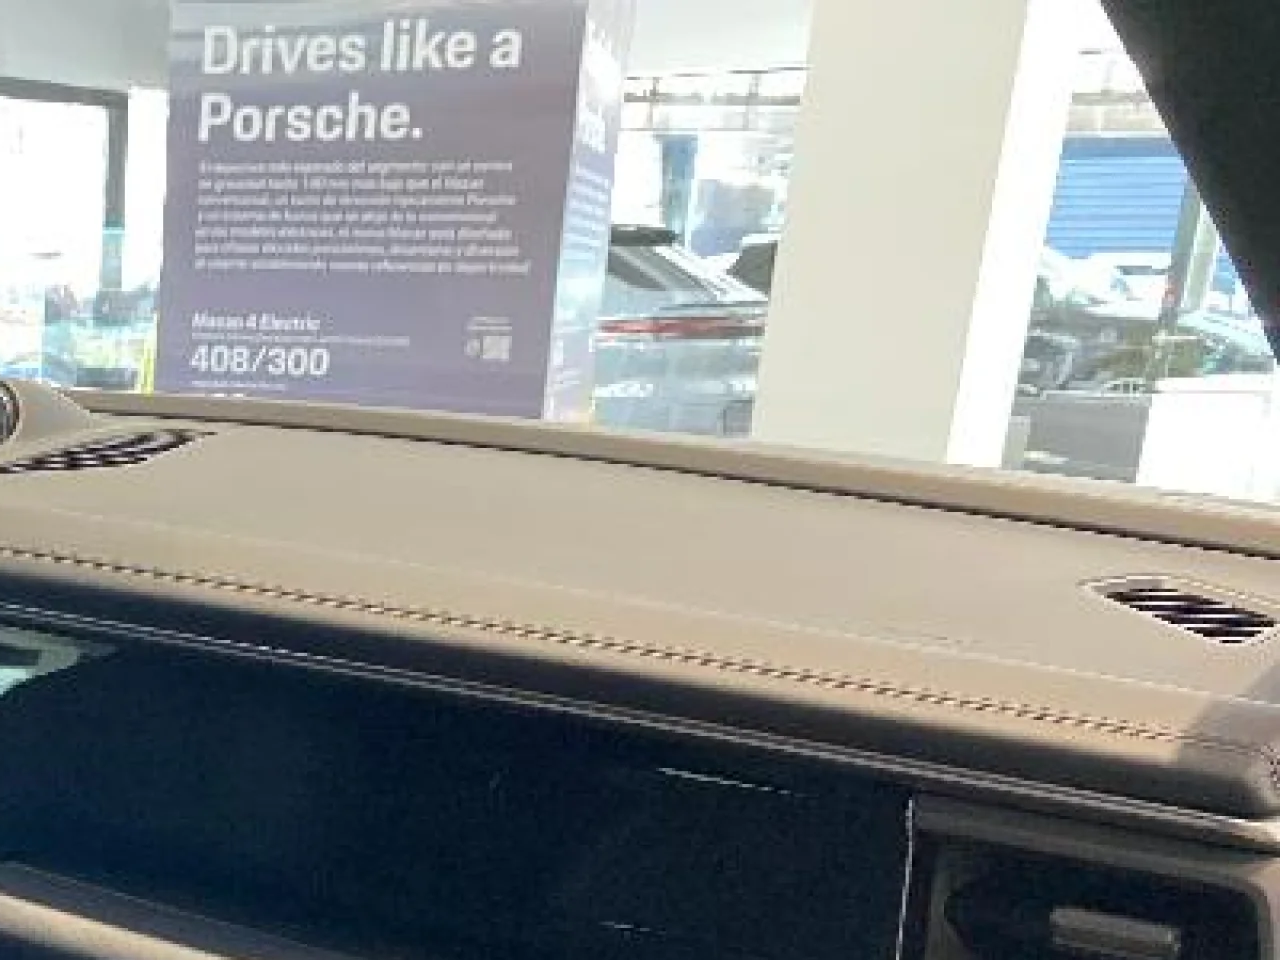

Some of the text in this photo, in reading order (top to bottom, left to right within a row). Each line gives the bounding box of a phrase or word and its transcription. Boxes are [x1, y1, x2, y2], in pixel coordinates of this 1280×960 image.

[202, 19, 520, 75] Drives like a
[198, 91, 423, 142] Porsche.
[190, 345, 330, 376] 408/300
